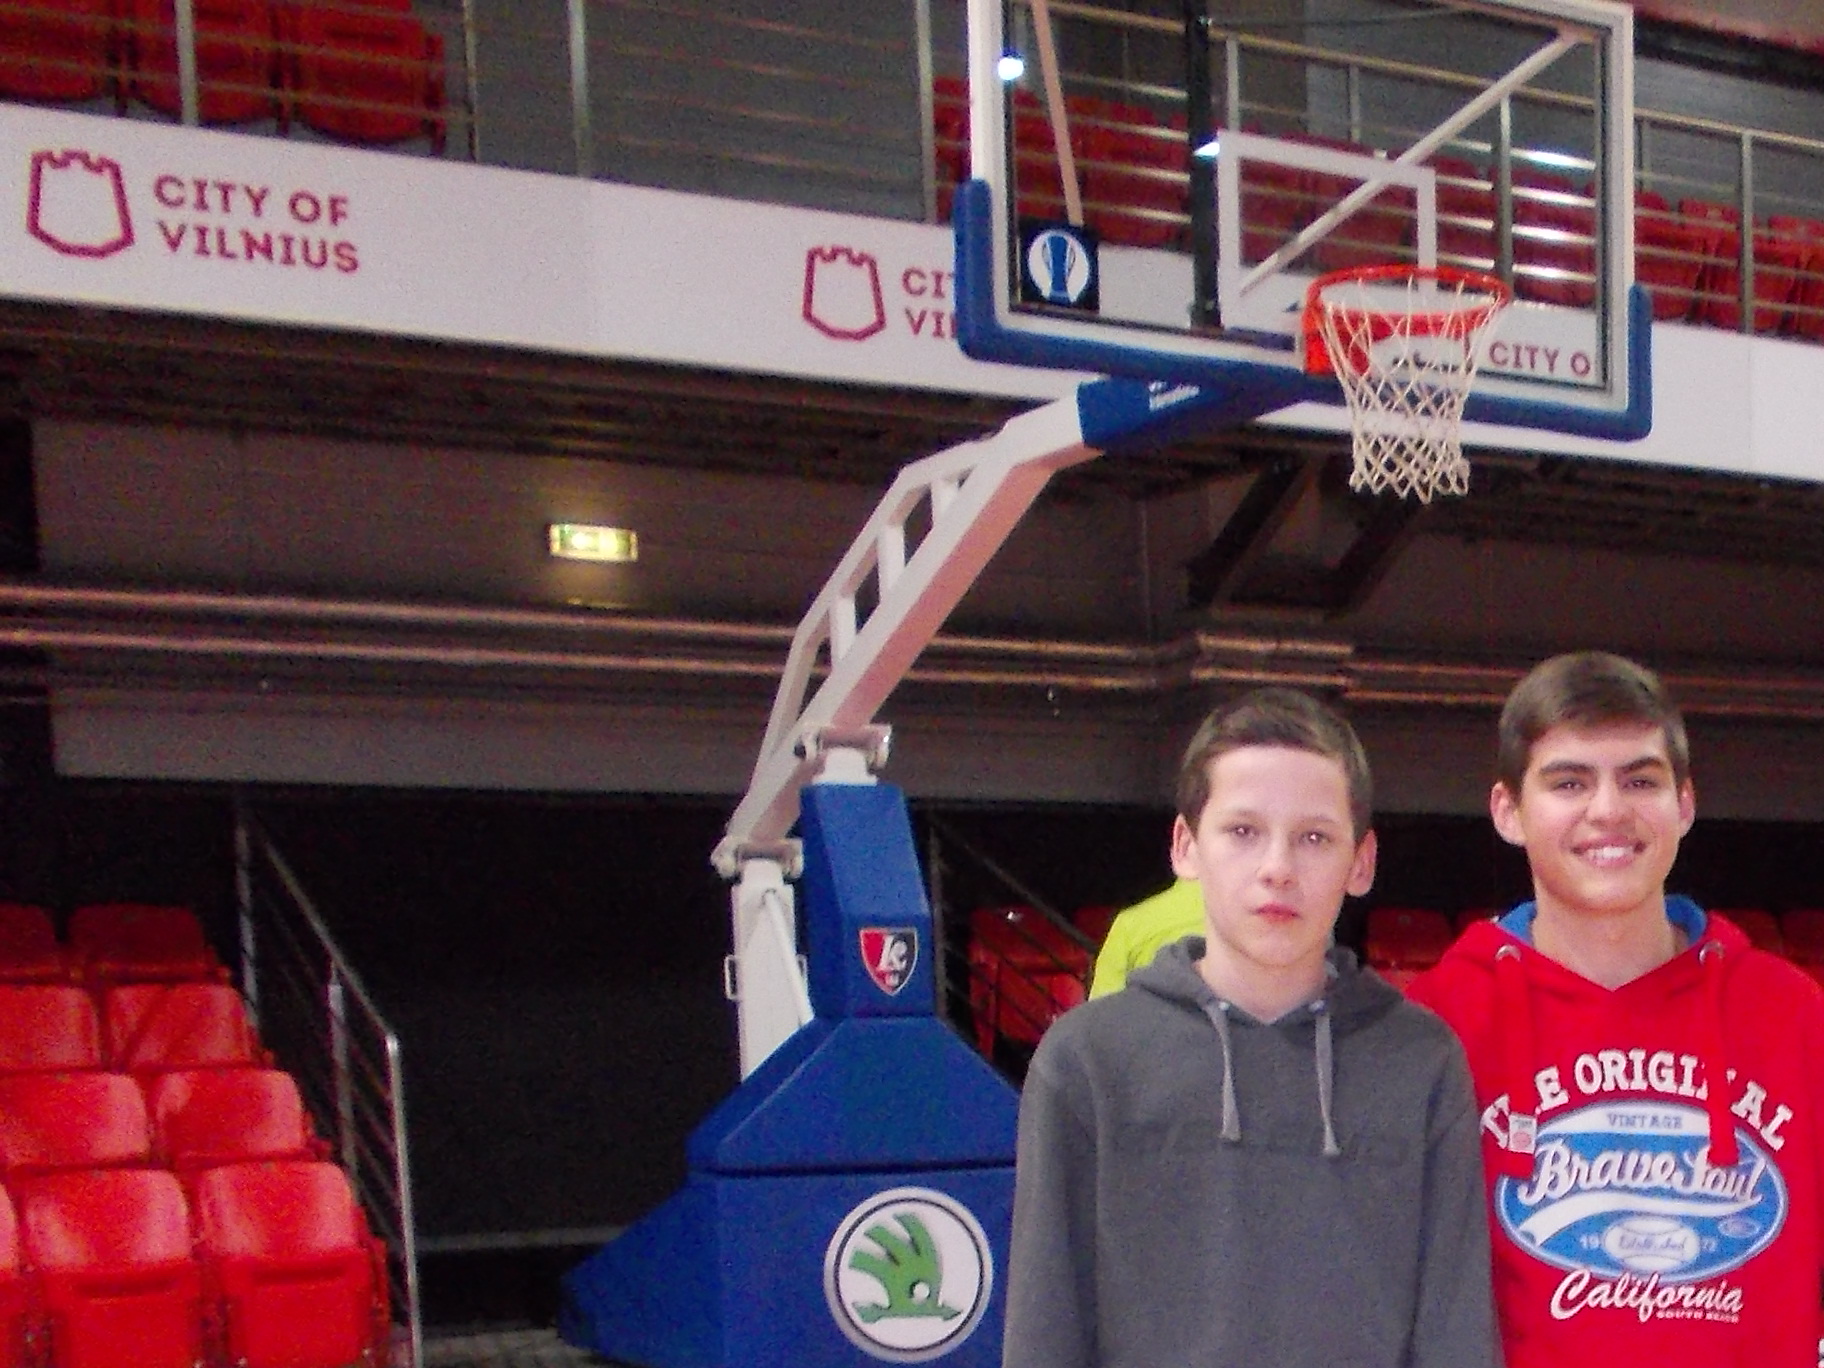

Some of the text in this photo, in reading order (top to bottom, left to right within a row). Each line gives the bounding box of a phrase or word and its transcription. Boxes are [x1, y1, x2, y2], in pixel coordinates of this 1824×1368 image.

[153, 173, 348, 227] CITY OF
[156, 218, 359, 274] VILNIUS
[901, 266, 955, 300] CI
[1488, 341, 1560, 374] CITY
[1570, 350, 1591, 377] O
[1480, 1065, 1569, 1150] TE
[1606, 1112, 1684, 1130] VINTAGE
[1550, 1267, 1744, 1324] California
